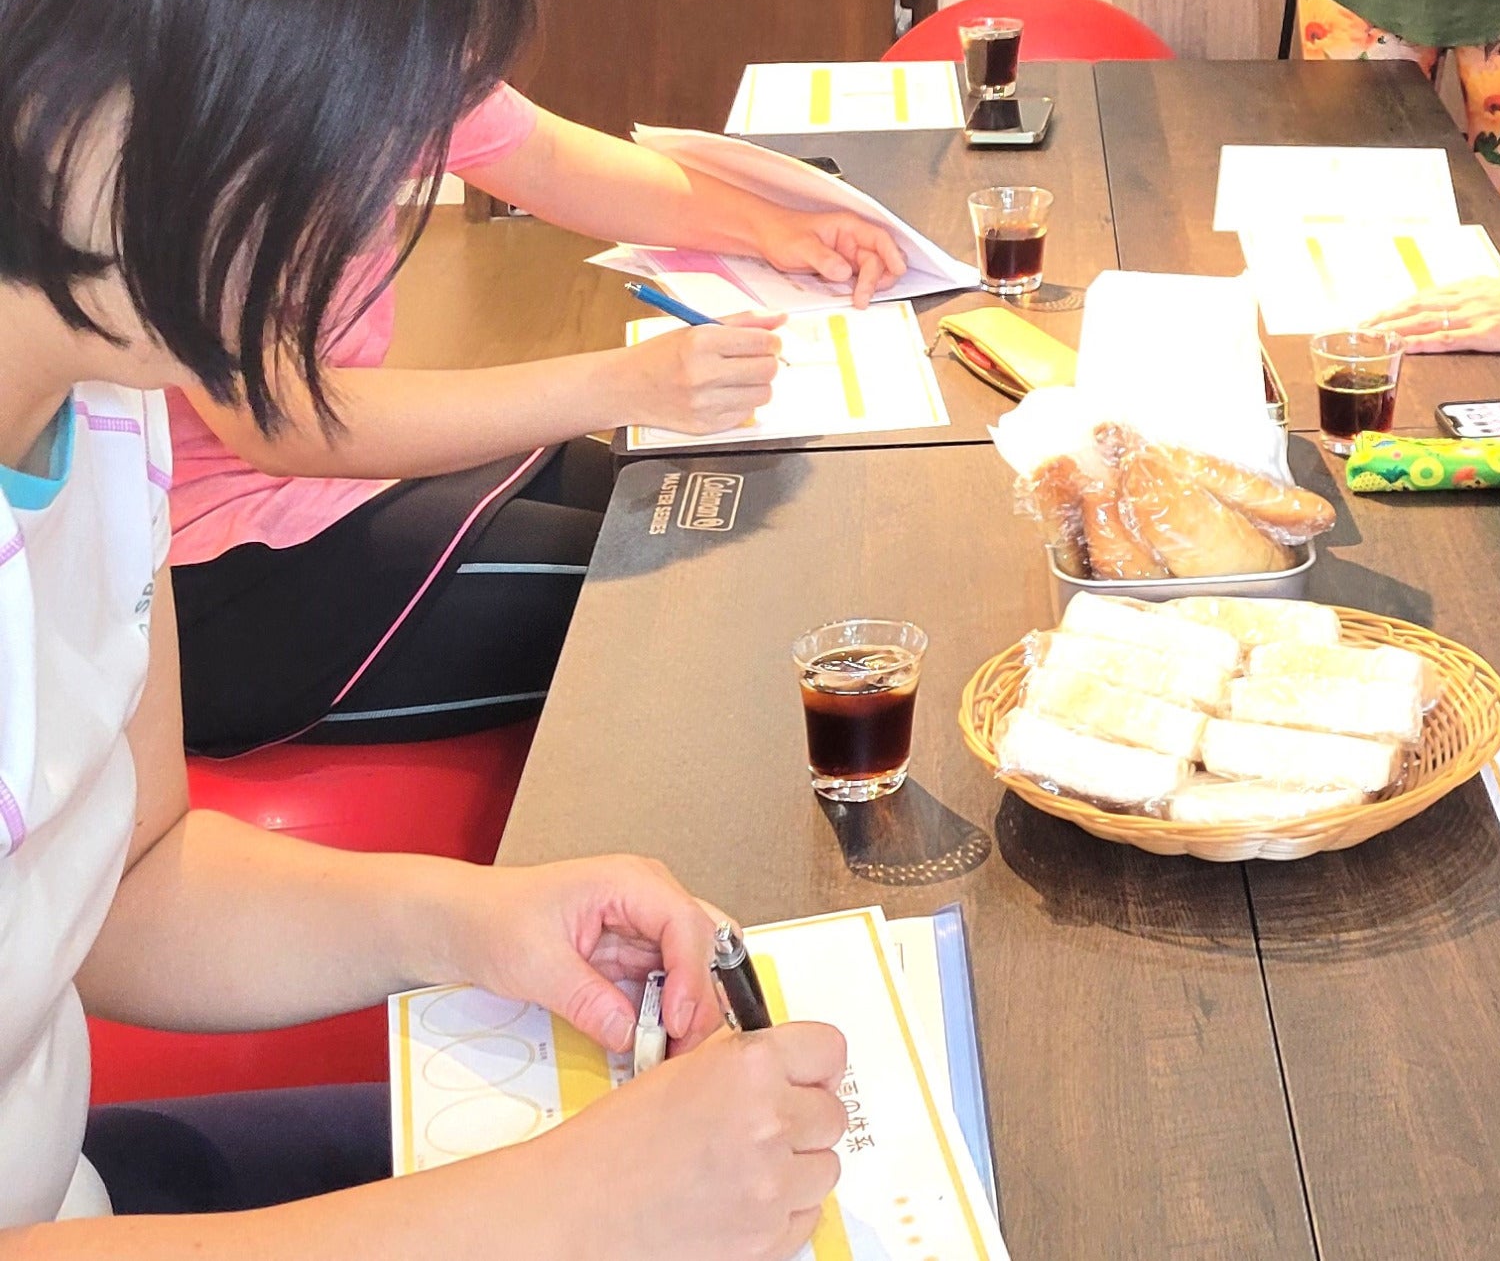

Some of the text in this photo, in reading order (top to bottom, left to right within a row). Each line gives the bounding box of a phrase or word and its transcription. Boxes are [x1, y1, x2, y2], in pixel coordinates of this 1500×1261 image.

[649, 472, 682, 535] MASTER SERIES
[695, 477, 736, 517] Coleman
